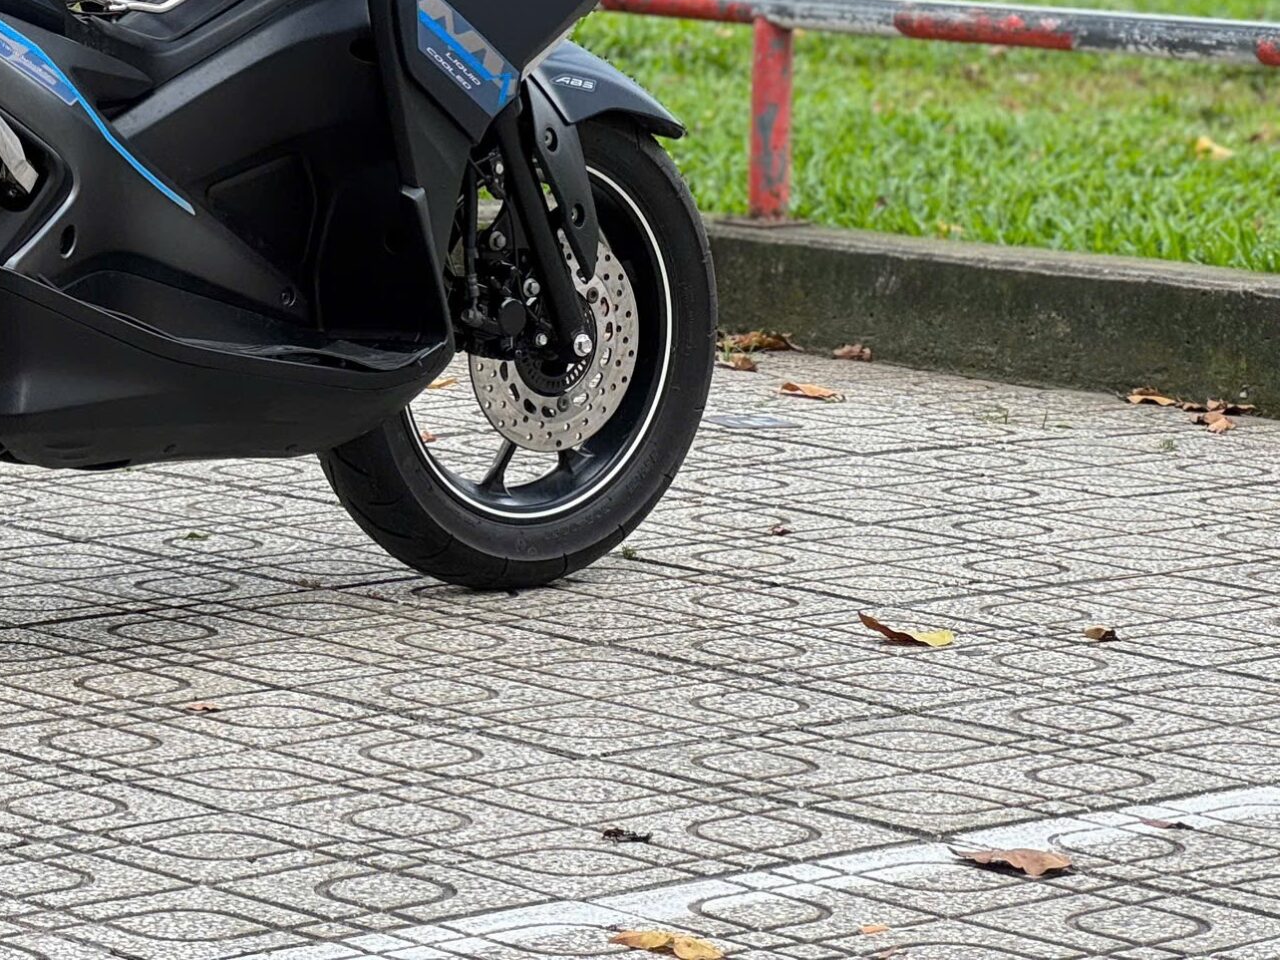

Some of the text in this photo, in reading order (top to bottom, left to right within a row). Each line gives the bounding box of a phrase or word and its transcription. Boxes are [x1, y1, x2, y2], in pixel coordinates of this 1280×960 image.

[426, 46, 472, 90] COOLED
[445, 51, 482, 86] LIQUID
[555, 76, 594, 90] ABS
